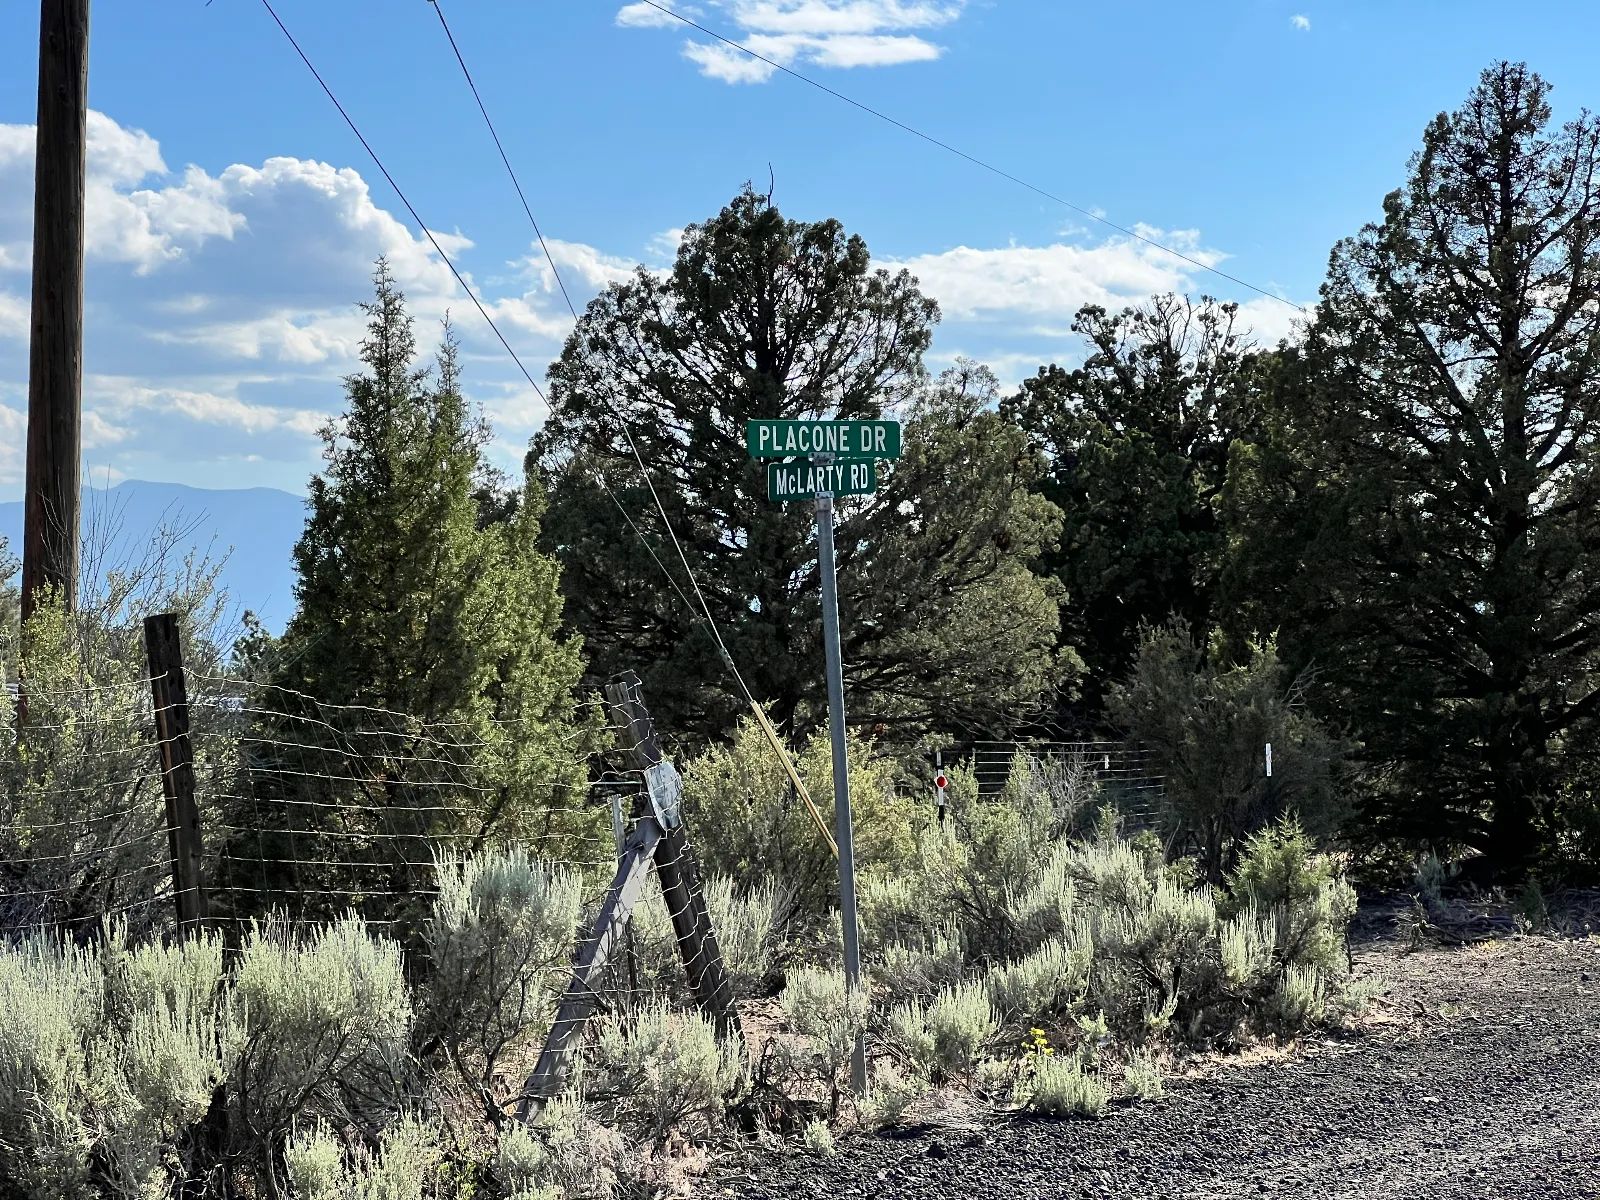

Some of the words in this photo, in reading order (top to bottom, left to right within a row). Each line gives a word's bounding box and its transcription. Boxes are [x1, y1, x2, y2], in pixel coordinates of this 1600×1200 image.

[759, 425, 850, 452] PLACONE
[860, 425, 887, 452] DR
[776, 465, 844, 495] McLARTY
[850, 463, 869, 490] RD
